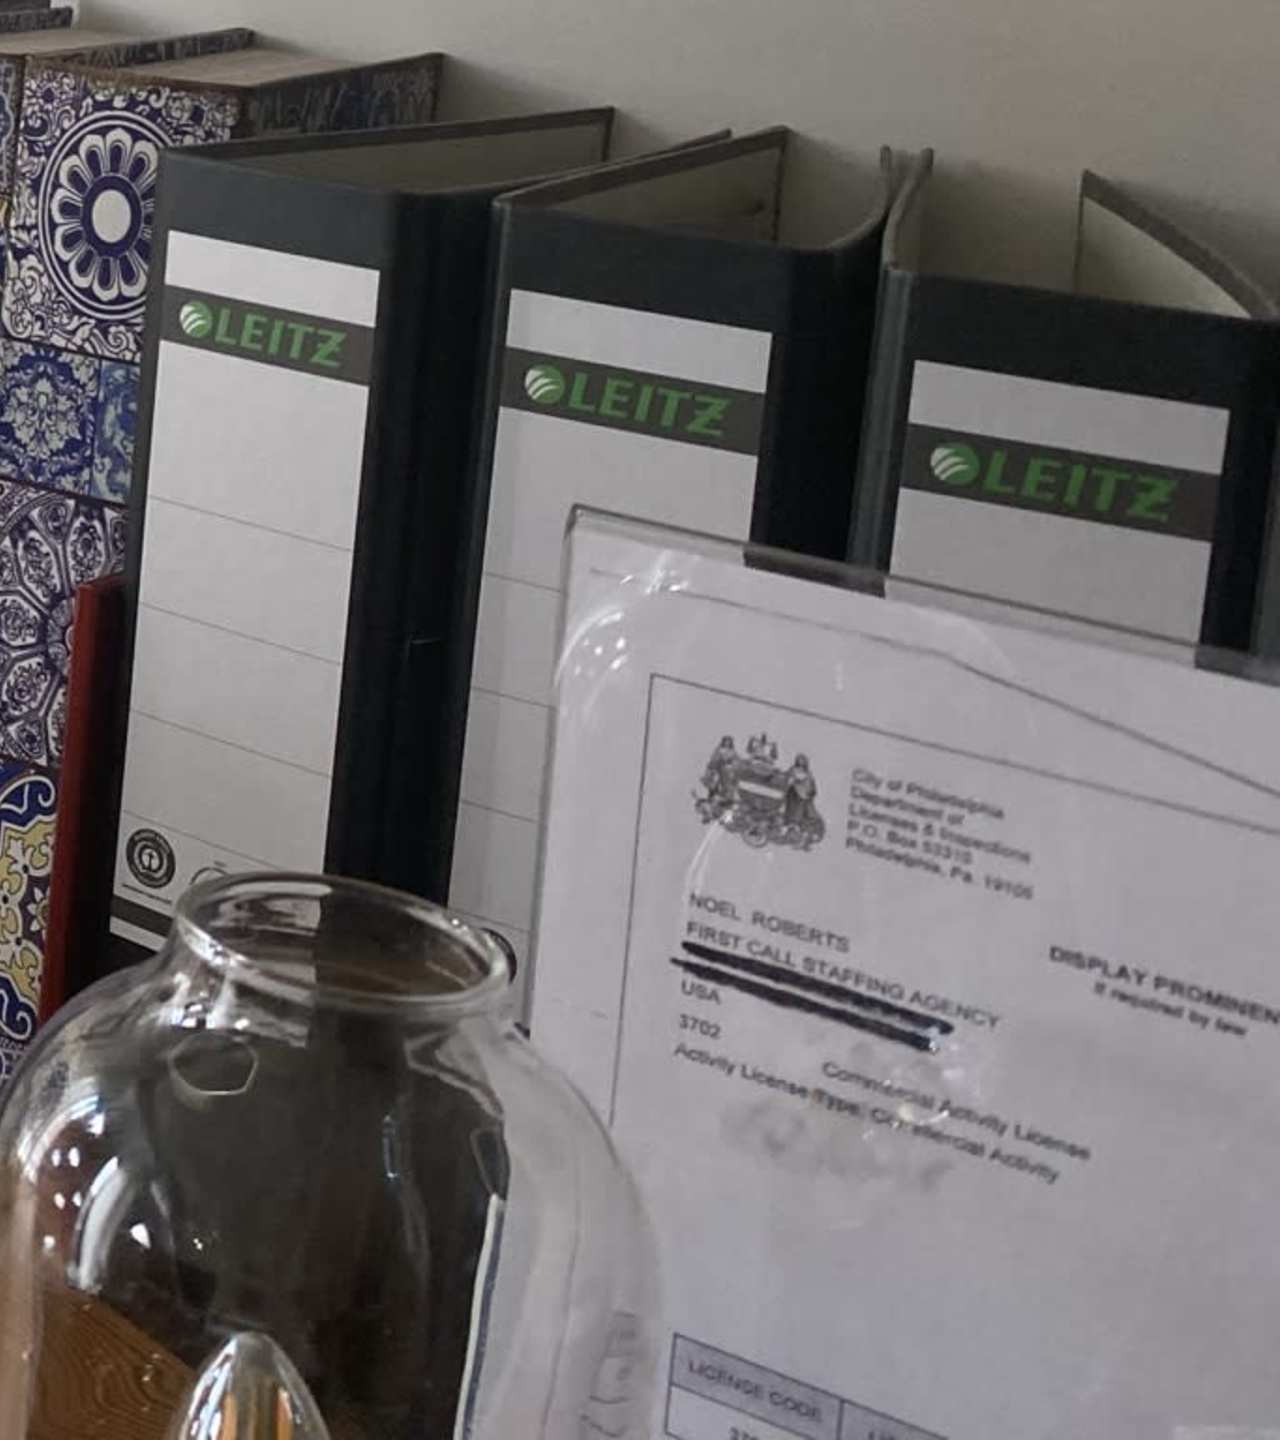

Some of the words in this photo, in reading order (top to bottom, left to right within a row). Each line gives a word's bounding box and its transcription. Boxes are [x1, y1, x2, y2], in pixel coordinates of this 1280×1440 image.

[215, 307, 347, 368] LEITZ
[568, 371, 733, 436] LEITZ
[983, 448, 1179, 522] LEITZ
[851, 767, 883, 789] City
[906, 781, 1005, 820] Philadelphia
[689, 892, 742, 921] NOEL
[751, 910, 851, 954] ROBERTS
[681, 978, 722, 1005] USA
[686, 920, 743, 950] FIRST
[746, 938, 797, 969] CALL
[802, 955, 906, 1001] STAFFING
[909, 990, 1002, 1029] AGENCY
[1049, 945, 1148, 986] DISPLAY
[679, 1013, 722, 1040] 3702
[674, 1042, 736, 1076] Activity
[740, 1063, 809, 1099] License
[870, 1107, 986, 1158] Comercial
[990, 1147, 1060, 1185] Activity
[821, 1060, 936, 1111] Commercial
[938, 1100, 1008, 1137] Activity
[1014, 1123, 1091, 1161] License
[688, 1360, 763, 1399] LICENSE
[768, 1390, 824, 1423] CODE
